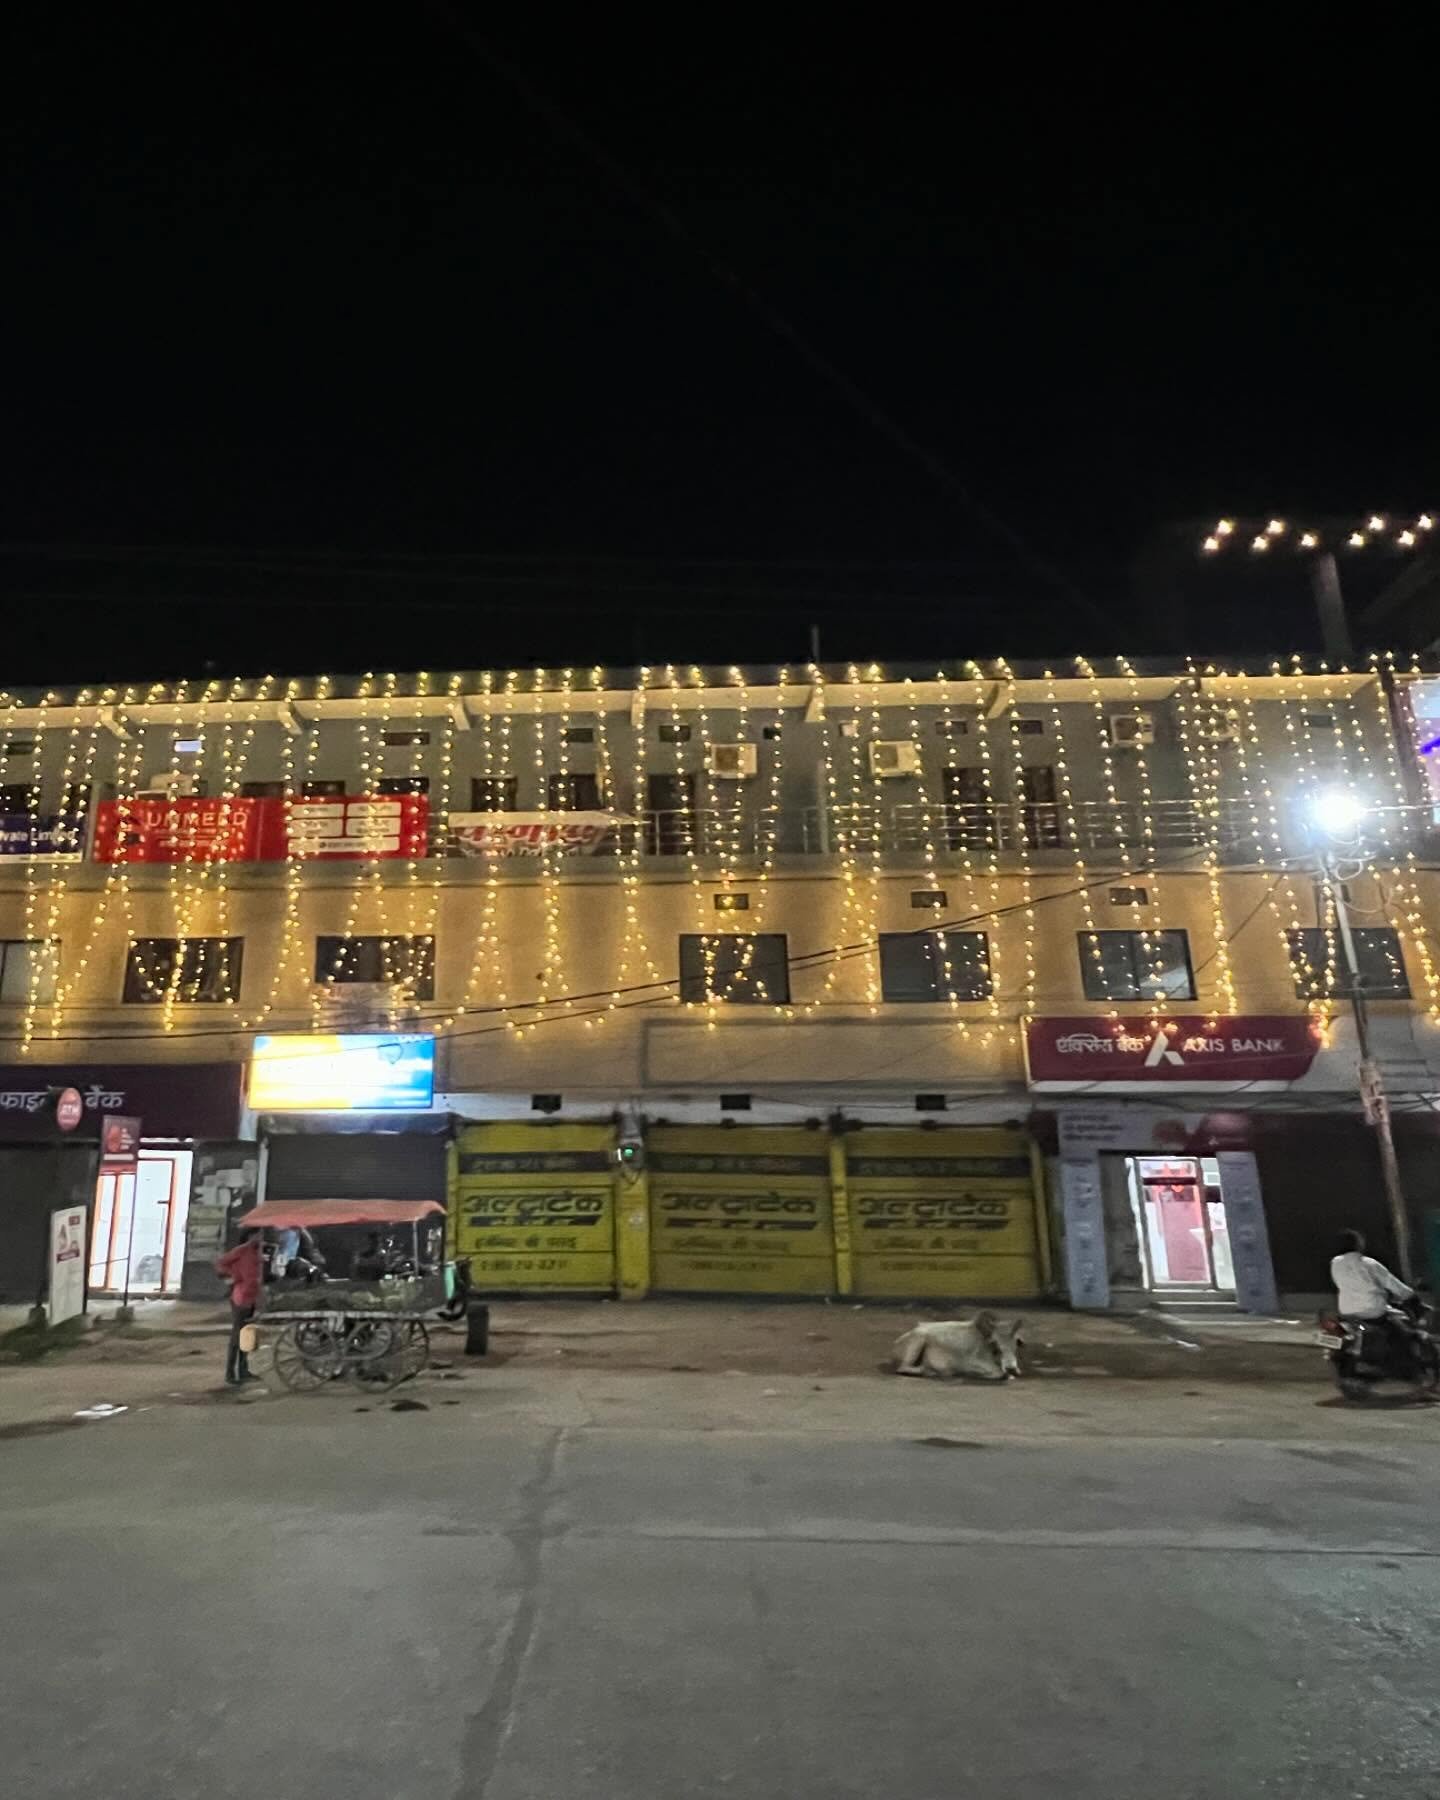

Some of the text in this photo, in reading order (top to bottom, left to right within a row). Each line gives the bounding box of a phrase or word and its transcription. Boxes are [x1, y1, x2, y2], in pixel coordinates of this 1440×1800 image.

[1182, 1038, 1284, 1052] AXIS BANK
[84, 1085, 126, 1109] बैंक
